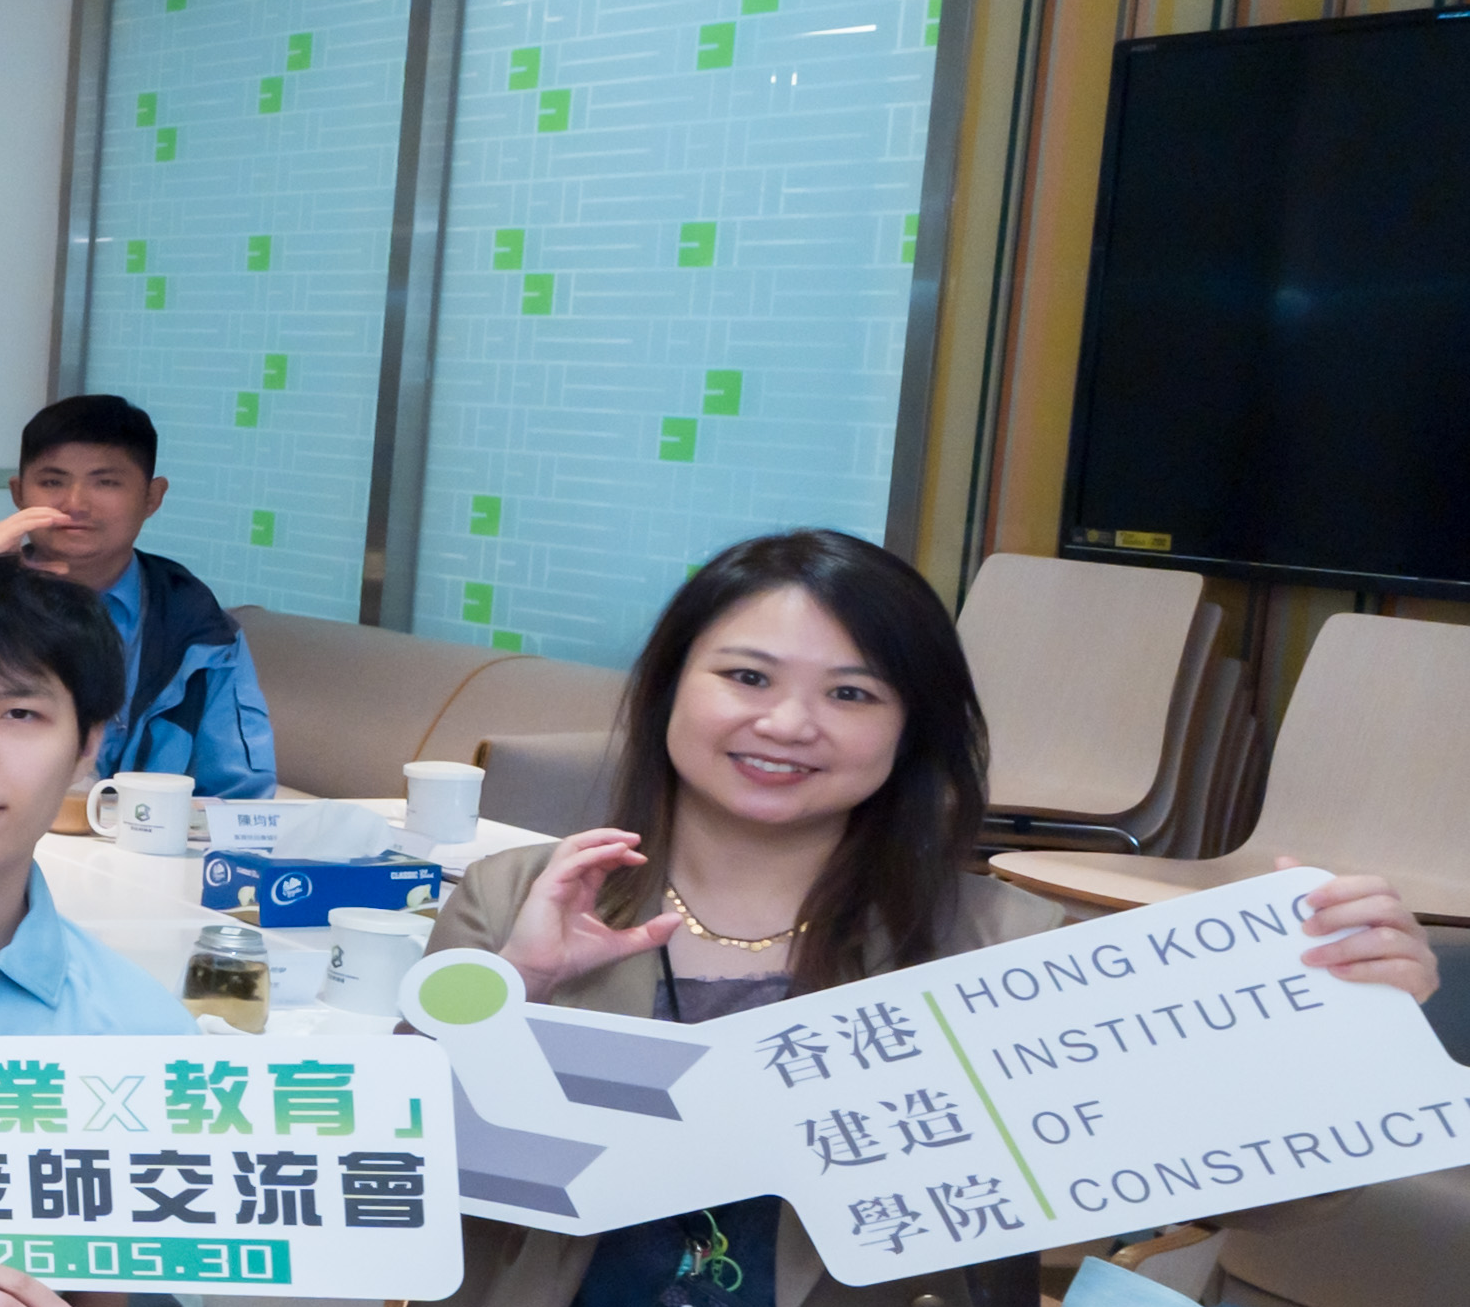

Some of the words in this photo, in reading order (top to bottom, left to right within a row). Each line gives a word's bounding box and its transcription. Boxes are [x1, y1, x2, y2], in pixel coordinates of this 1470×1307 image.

[955, 944, 1136, 1014] HONG
[755, 1002, 923, 1088] 香港
[992, 973, 1325, 1080] INSTITUTE
[794, 1088, 974, 1175] 建造
[1032, 1100, 1104, 1145] OF
[1069, 1097, 1470, 1212] CONSTRUCT
[848, 1174, 1025, 1255] 學院
